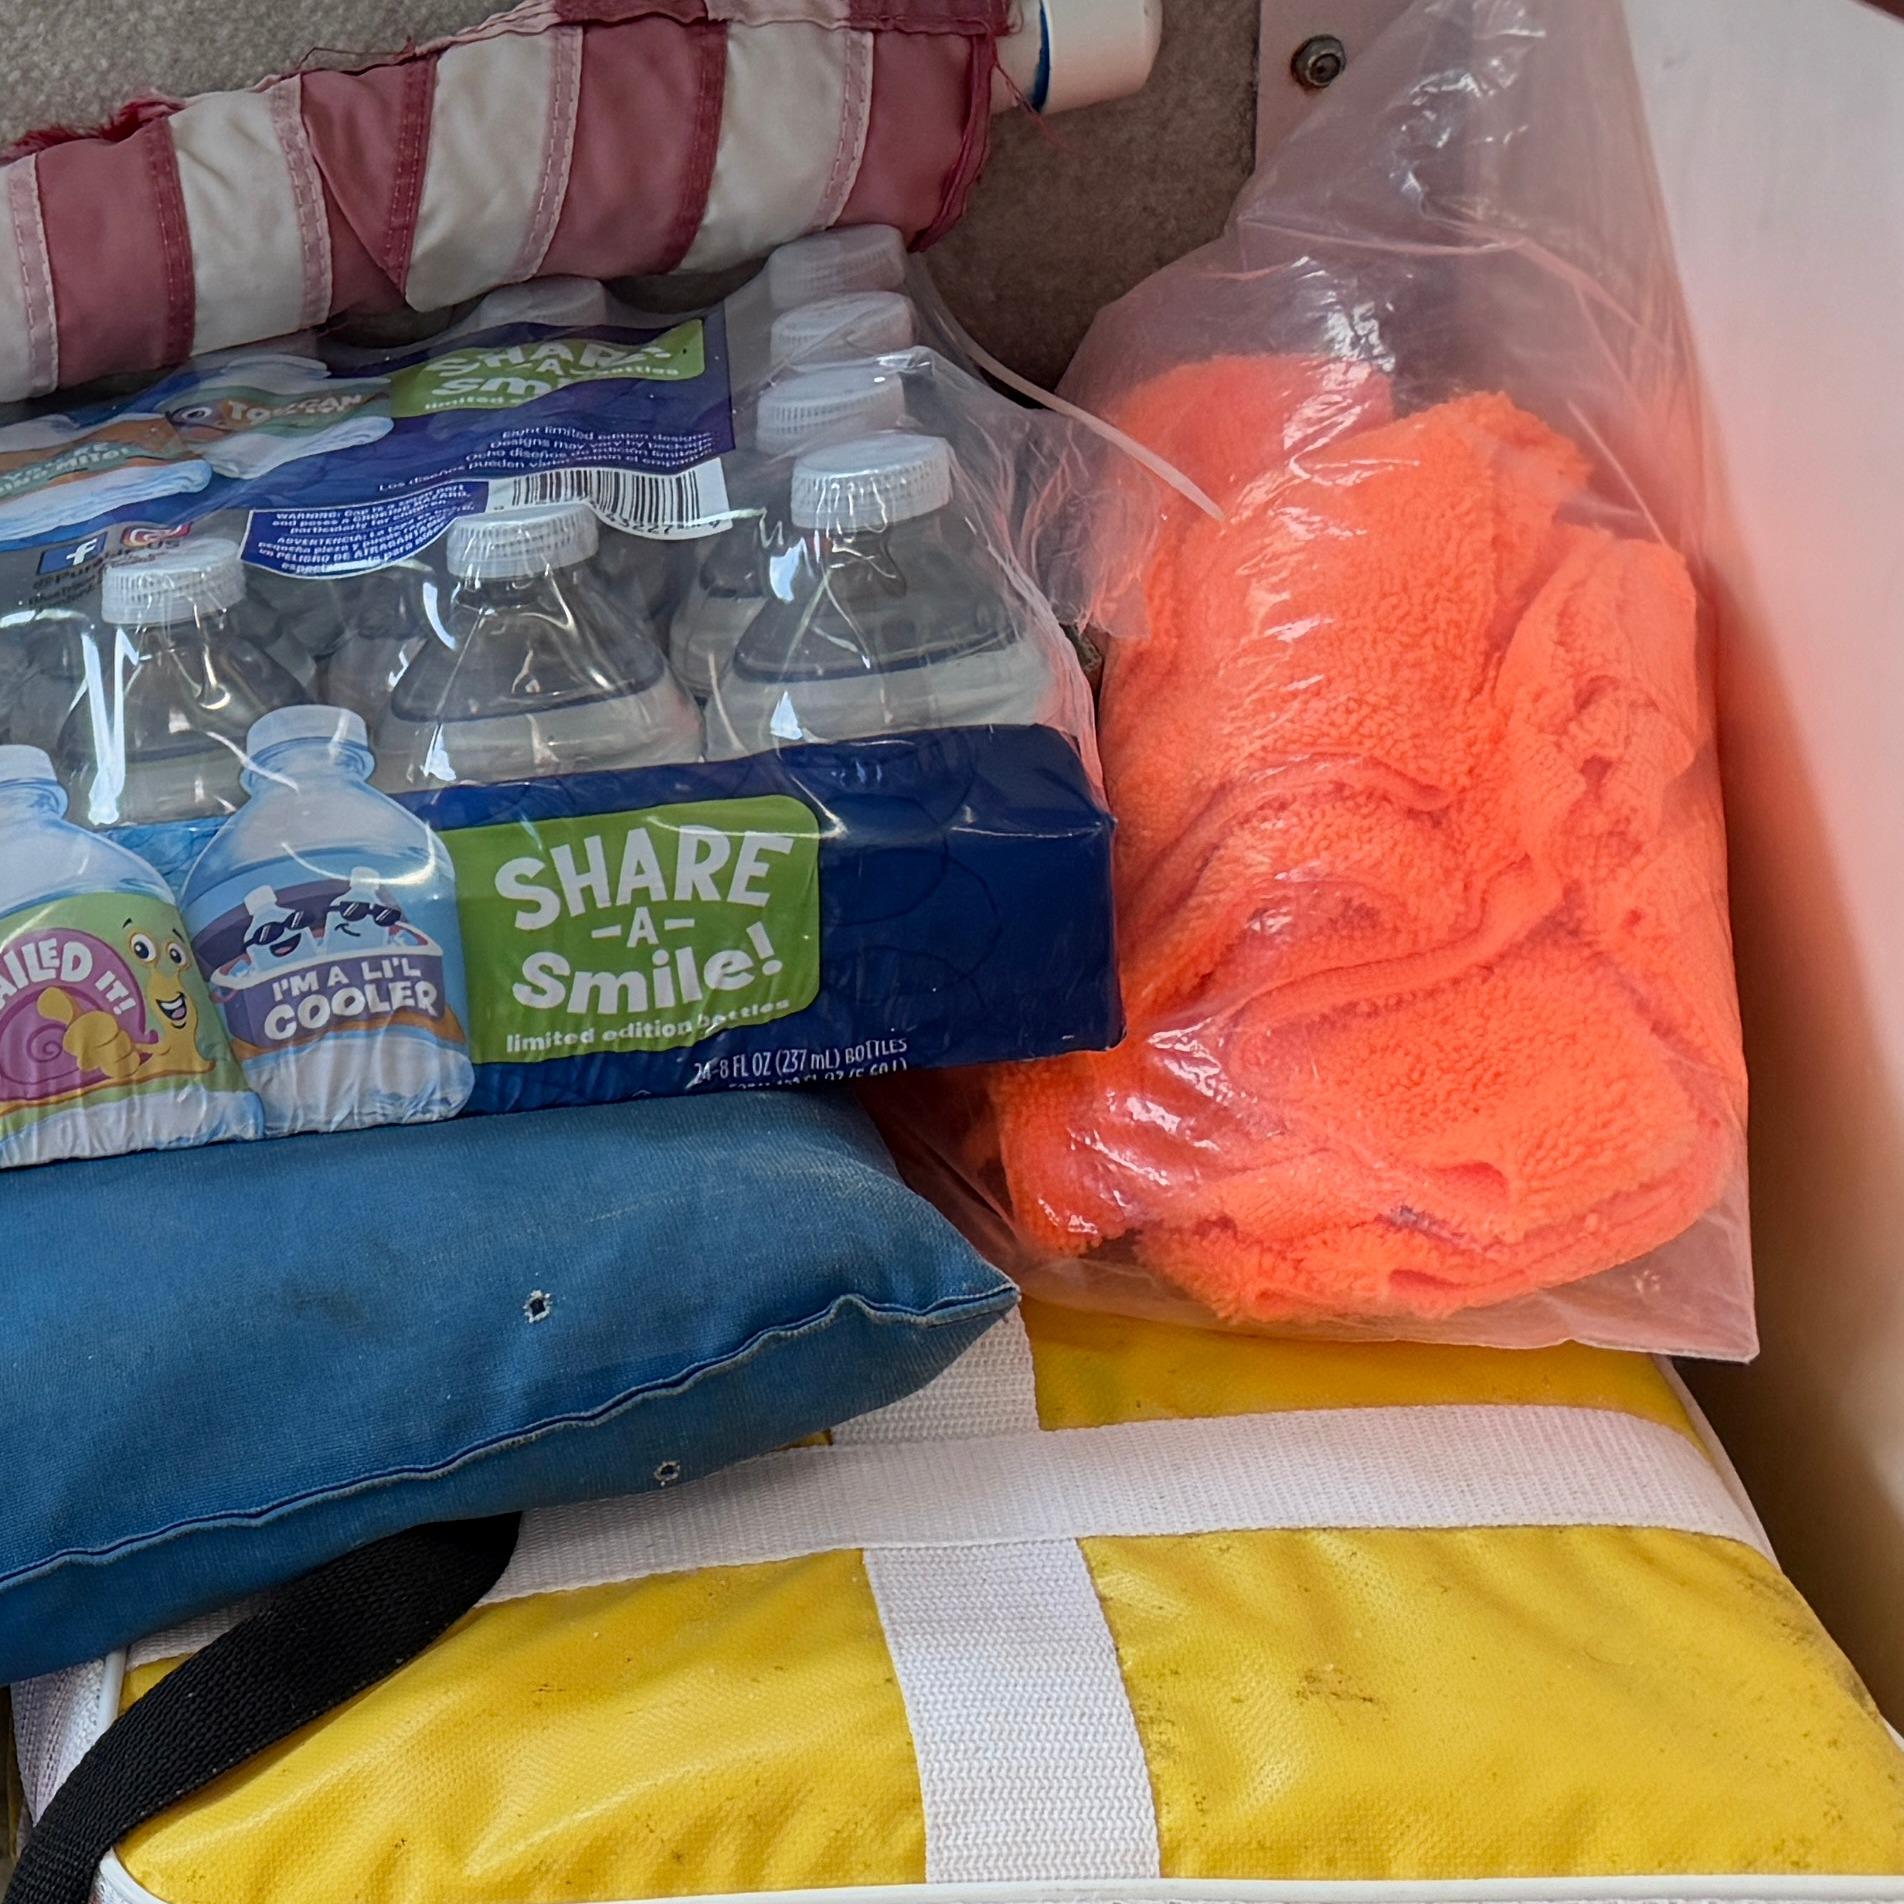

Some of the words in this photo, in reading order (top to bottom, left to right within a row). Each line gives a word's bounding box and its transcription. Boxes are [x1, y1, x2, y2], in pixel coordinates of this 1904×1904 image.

[494, 825, 795, 931] SHARE
[272, 970, 320, 1002] I'M
[327, 965, 350, 988] A
[360, 956, 422, 981] LI'L
[512, 920, 784, 1015] Smile!
[94, 970, 138, 1016] IT!
[263, 980, 439, 1041] COOLER
[505, 1027, 596, 1054] limited
[601, 1013, 692, 1042] edition
[733, 1053, 749, 1079] FL
[752, 1052, 772, 1077] OZ
[775, 1048, 808, 1077] (237
[810, 1048, 841, 1072] mL)
[845, 1038, 909, 1065] BOTTLES
